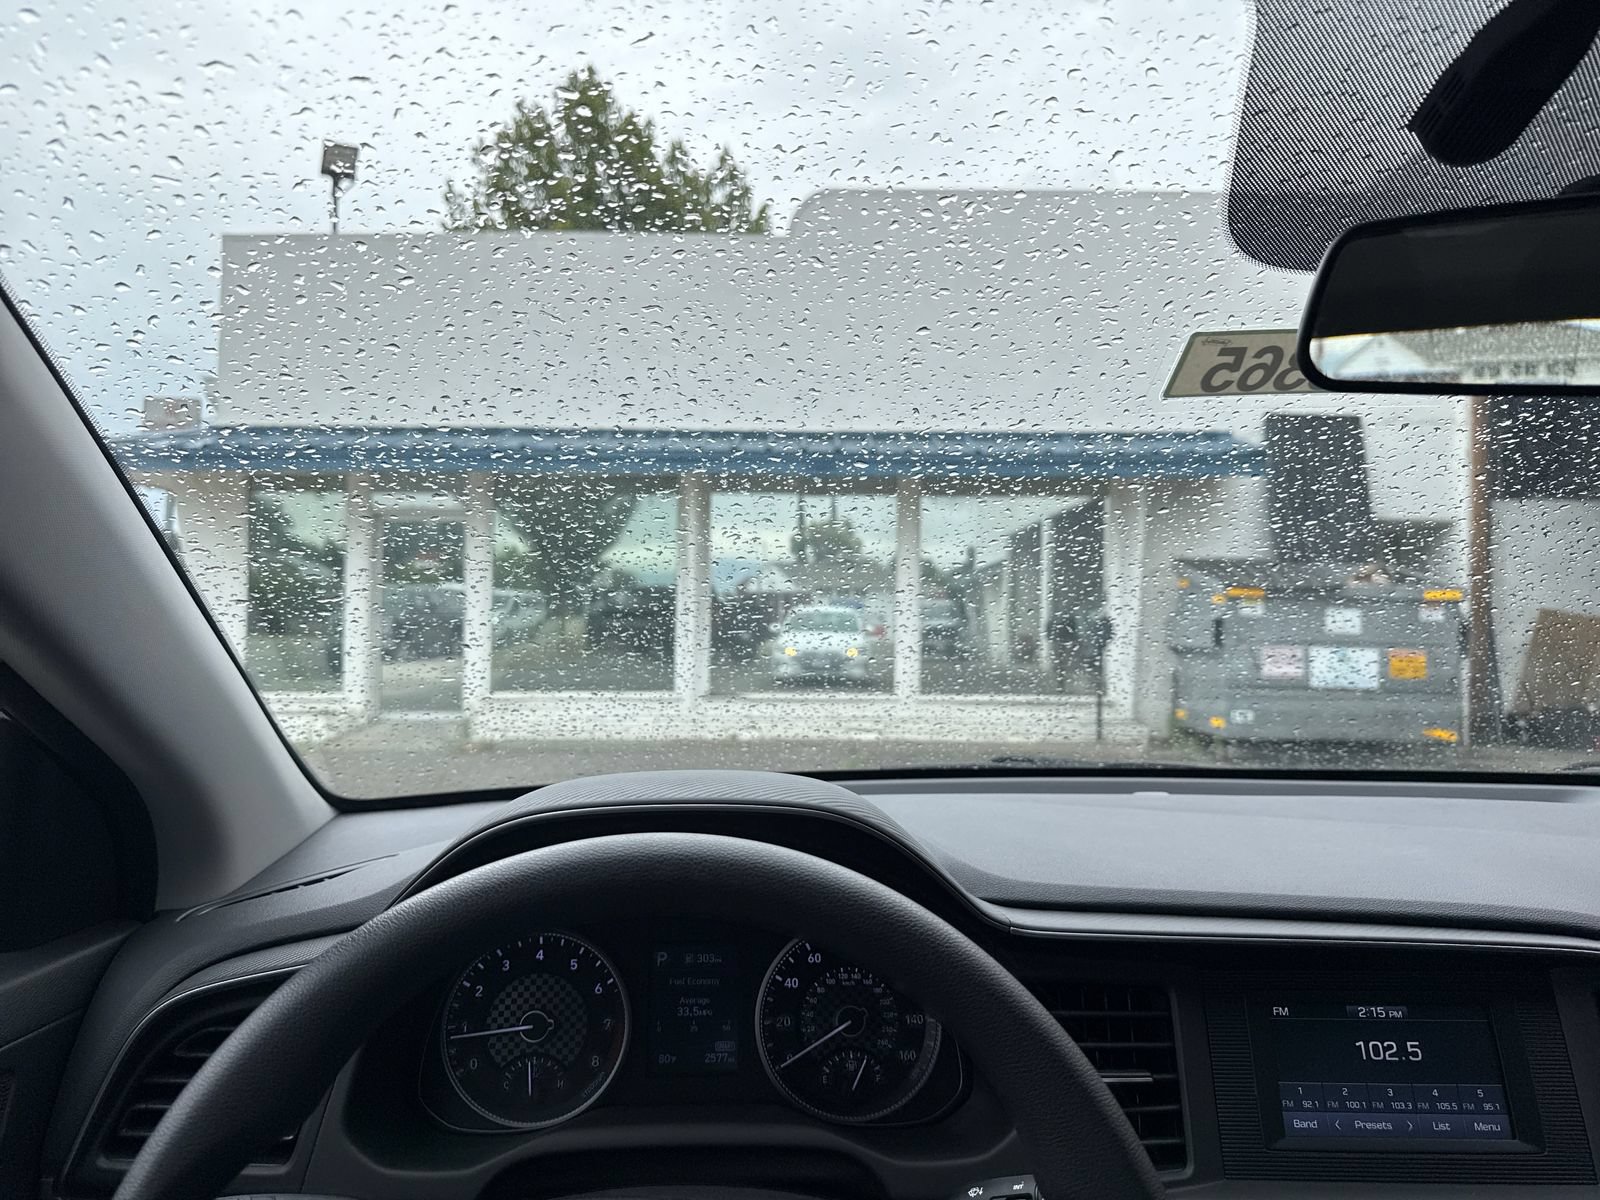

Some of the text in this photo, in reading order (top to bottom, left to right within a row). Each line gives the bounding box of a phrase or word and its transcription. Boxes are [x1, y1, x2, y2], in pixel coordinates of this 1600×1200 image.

[535, 949, 544, 960] 4
[657, 951, 668, 967] P
[807, 953, 821, 963] 60
[502, 961, 510, 971] 3
[570, 959, 578, 970] 5
[784, 977, 799, 988] 40
[475, 987, 483, 997] 2
[594, 984, 603, 994] 6
[1273, 1007, 1289, 1016] FM
[1357, 1007, 1386, 1018] 2:15
[776, 1016, 791, 1026] 20
[905, 1014, 924, 1025] 140
[899, 1050, 916, 1061] 160
[1355, 1040, 1423, 1061] 102.5
[469, 1058, 478, 1069] 0
[591, 1056, 600, 1067] 8
[1342, 1088, 1349, 1096] 2
[1387, 1089, 1394, 1097] 3
[1432, 1089, 1439, 1097] 4
[1477, 1089, 1484, 1097] 5
[1282, 1100, 1319, 1108] FM 92.1
[1345, 1101, 1367, 1109] 100.1
[1372, 1101, 1412, 1110] FM 103.3
[1417, 1102, 1458, 1111] FM 105.5
[1462, 1103, 1500, 1111] FM 95.1
[1293, 1119, 1318, 1129] Band
[1354, 1120, 1393, 1130] Presets
[1432, 1121, 1451, 1131] List
[1474, 1122, 1501, 1132] Menu
